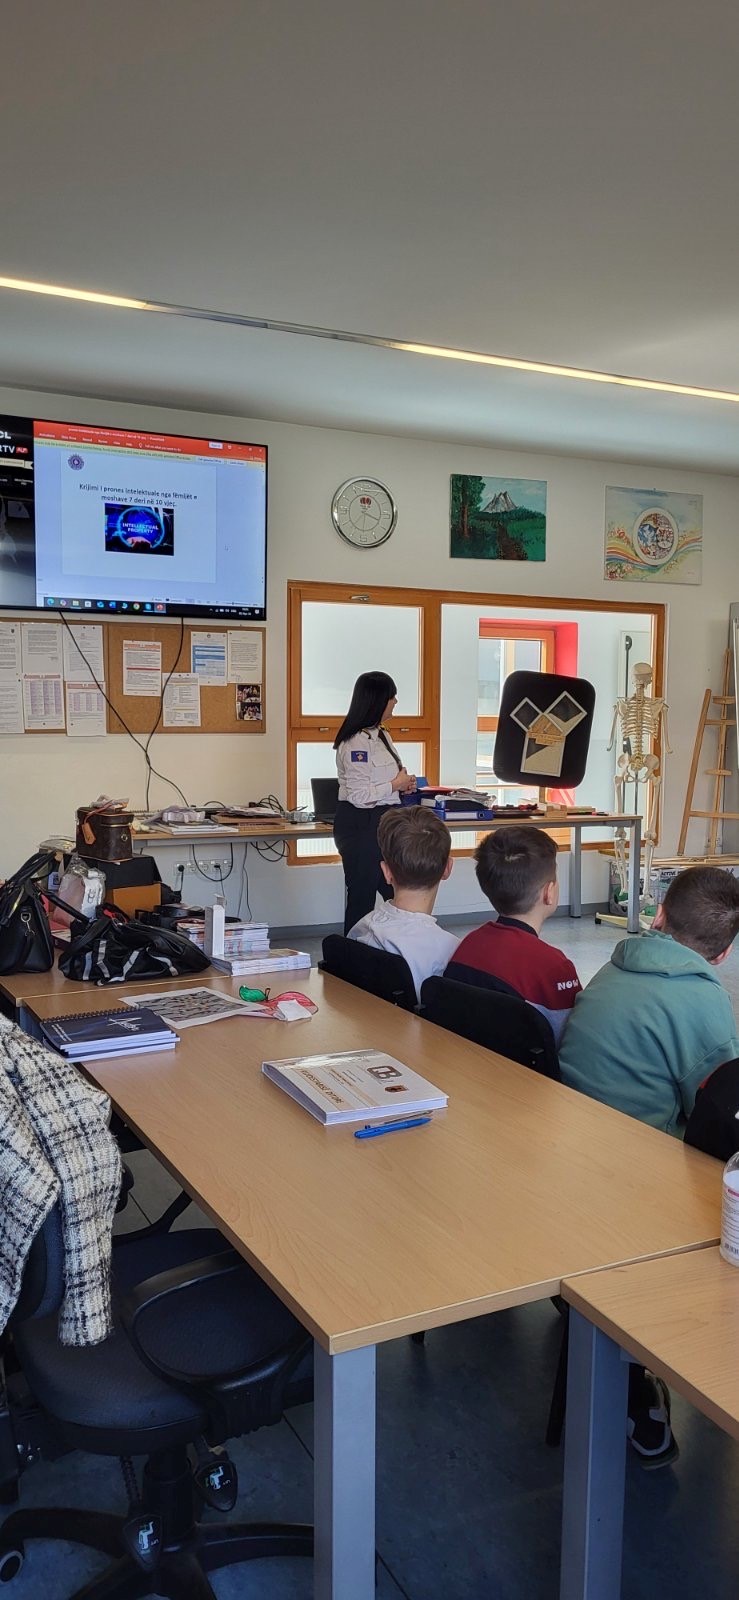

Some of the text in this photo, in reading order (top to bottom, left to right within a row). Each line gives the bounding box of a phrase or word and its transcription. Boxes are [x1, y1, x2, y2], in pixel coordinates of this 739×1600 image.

[79, 483, 99, 492] Krijimi
[103, 486, 124, 494] prones
[160, 491, 171, 499] nga
[101, 495, 128, 503] moshave
[122, 522, 159, 530] INTELLECTUAL
